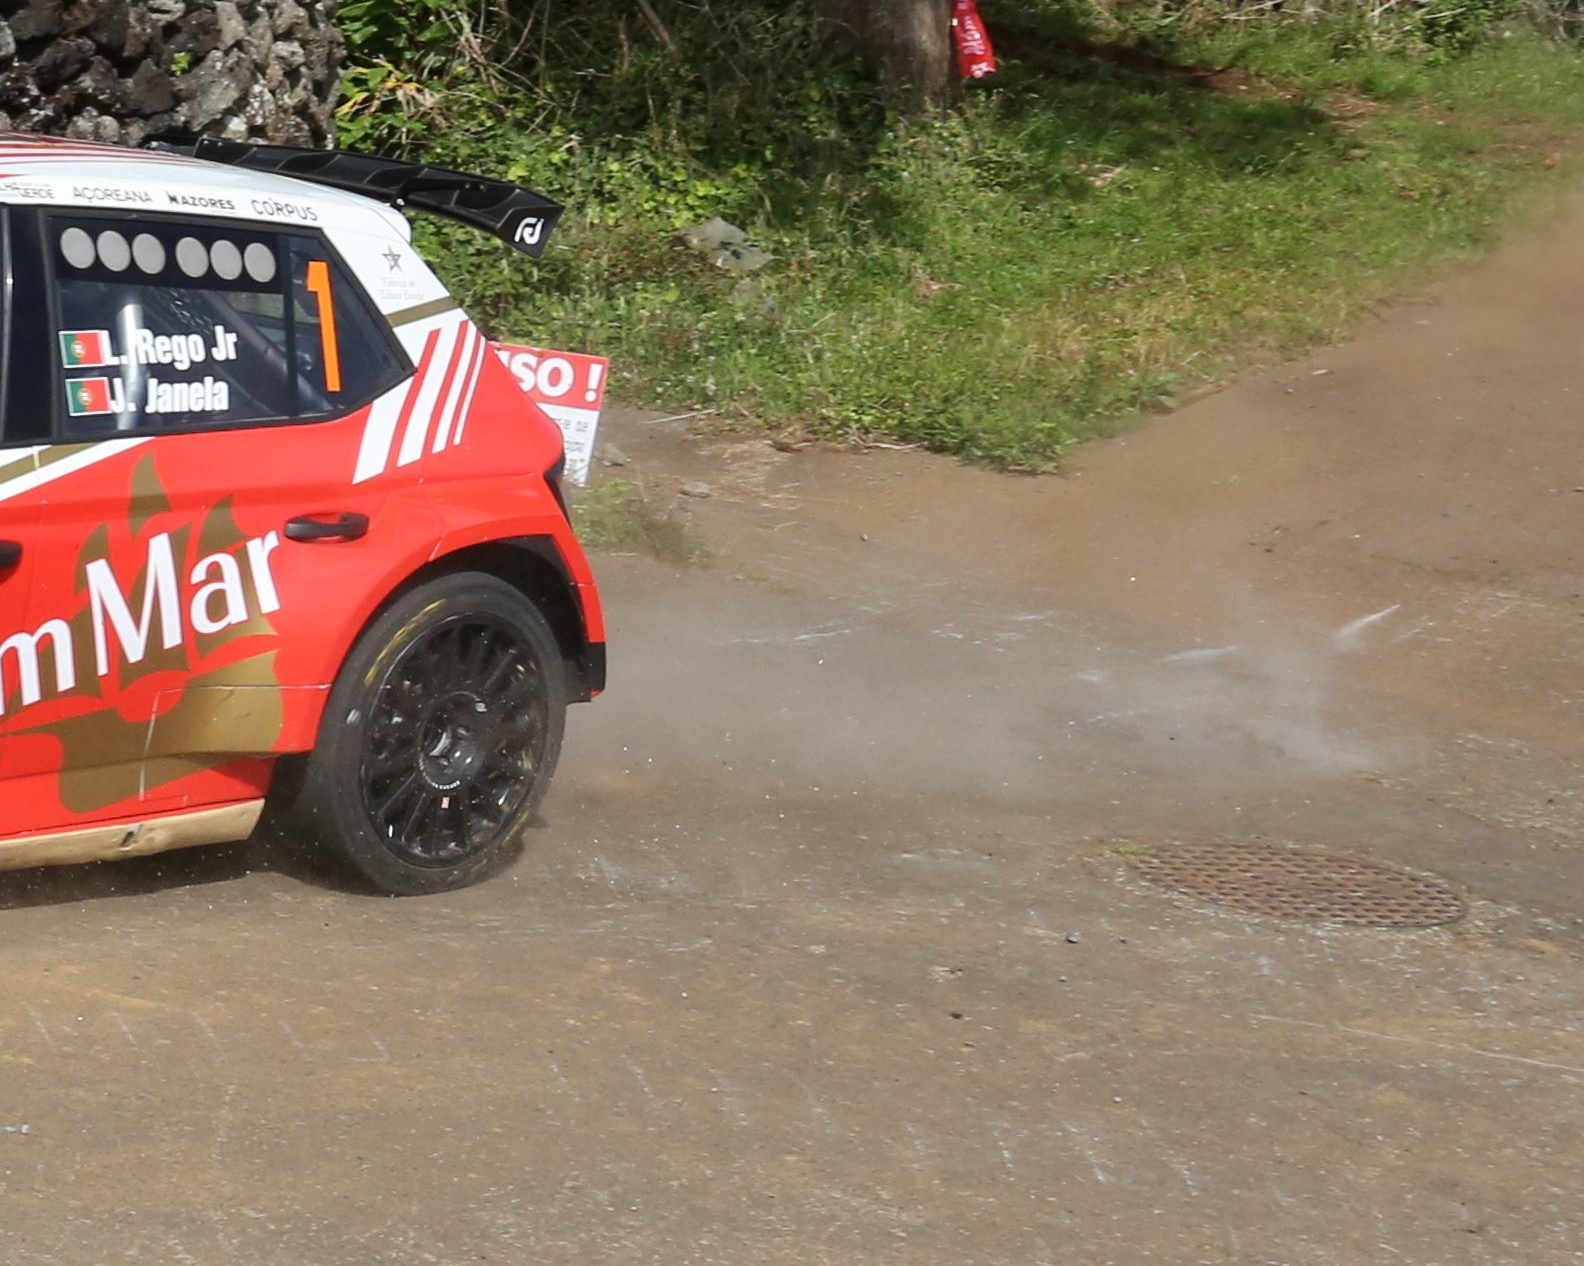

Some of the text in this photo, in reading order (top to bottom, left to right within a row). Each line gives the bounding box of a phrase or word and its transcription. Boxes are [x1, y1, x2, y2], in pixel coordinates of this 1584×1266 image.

[72, 185, 154, 203] AÇOREANA
[307, 260, 341, 393] 1
[101, 325, 238, 371] L. Rego Jr
[110, 376, 230, 414] J. Janela
